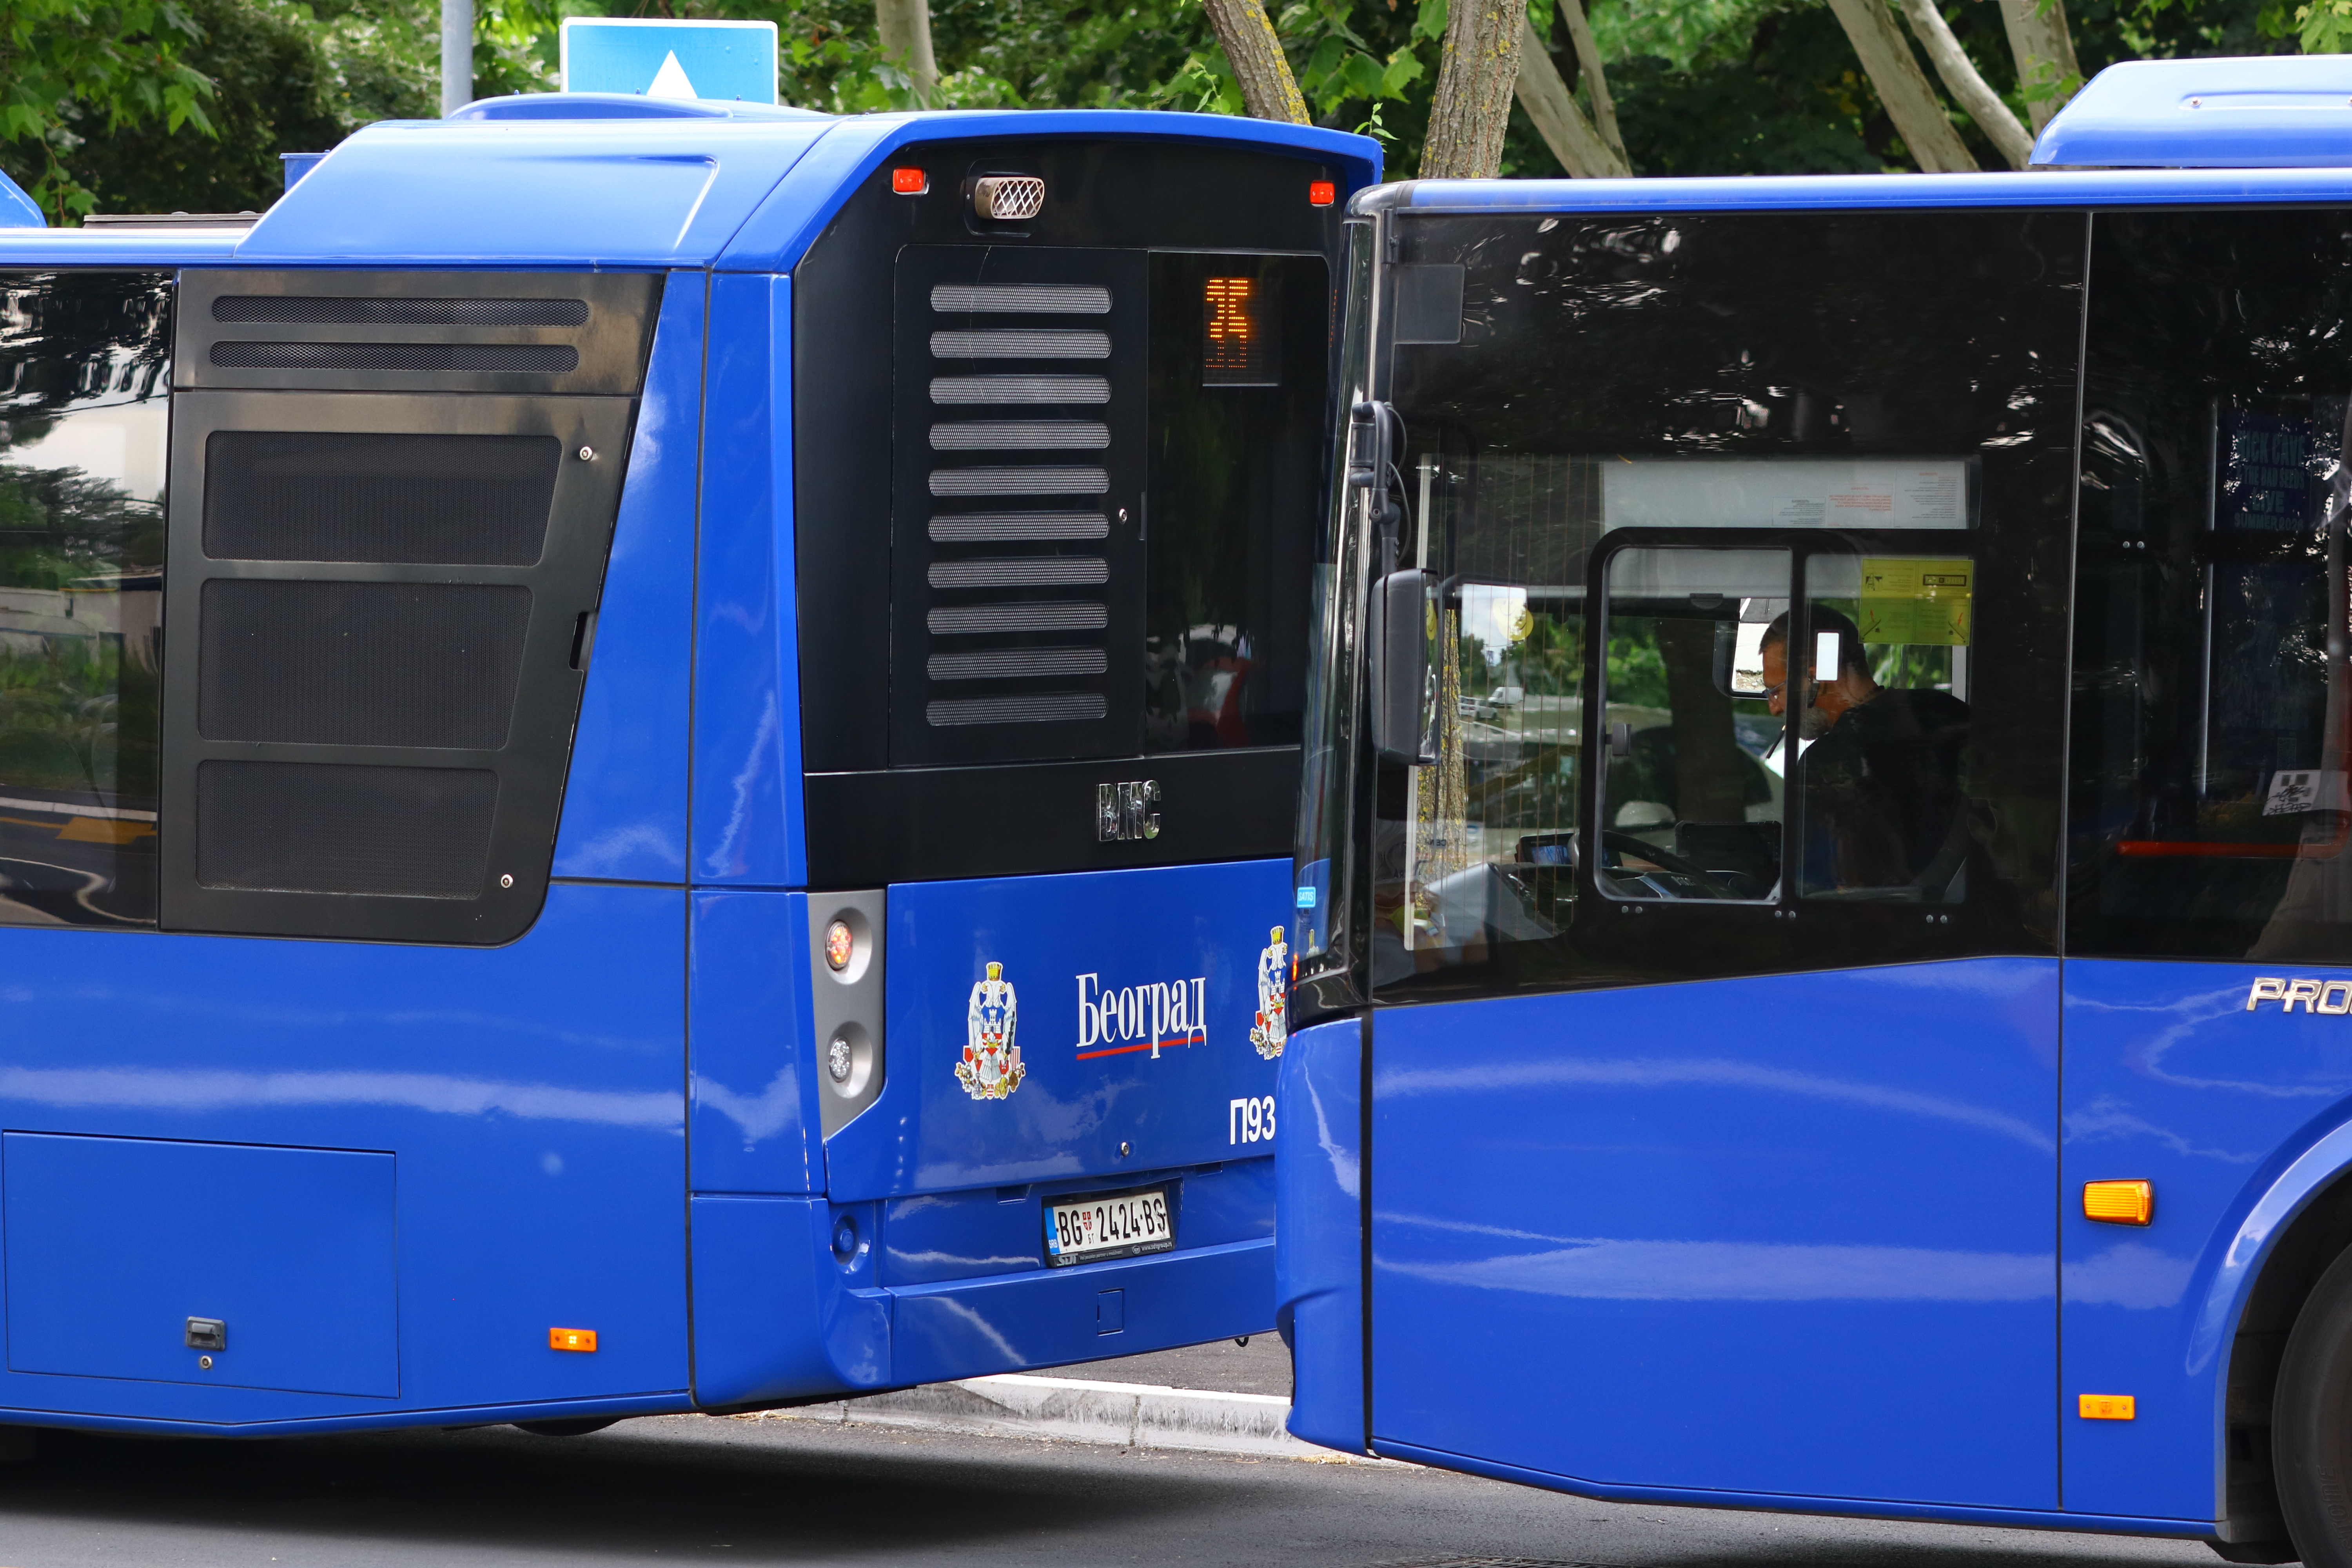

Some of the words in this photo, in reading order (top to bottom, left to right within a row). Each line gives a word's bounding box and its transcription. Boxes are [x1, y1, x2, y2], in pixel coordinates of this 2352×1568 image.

[2272, 433, 2305, 467] CAVE
[2244, 465, 2259, 485] THE
[2261, 466, 2278, 487] BAD
[2279, 468, 2305, 490] SEEDS
[2252, 488, 2284, 513] LIVE
[2234, 512, 2277, 530] SUMMER
[1096, 780, 1161, 841] BMC
[2246, 977, 2352, 1014] PRO
[1076, 972, 1207, 1059] Београд
[1058, 1210, 1082, 1247] BG
[1049, 1239, 1058, 1249] SRB
[1141, 1242, 1172, 1251] www.sdtgroup.rs
[1057, 1254, 1078, 1266] SDT
